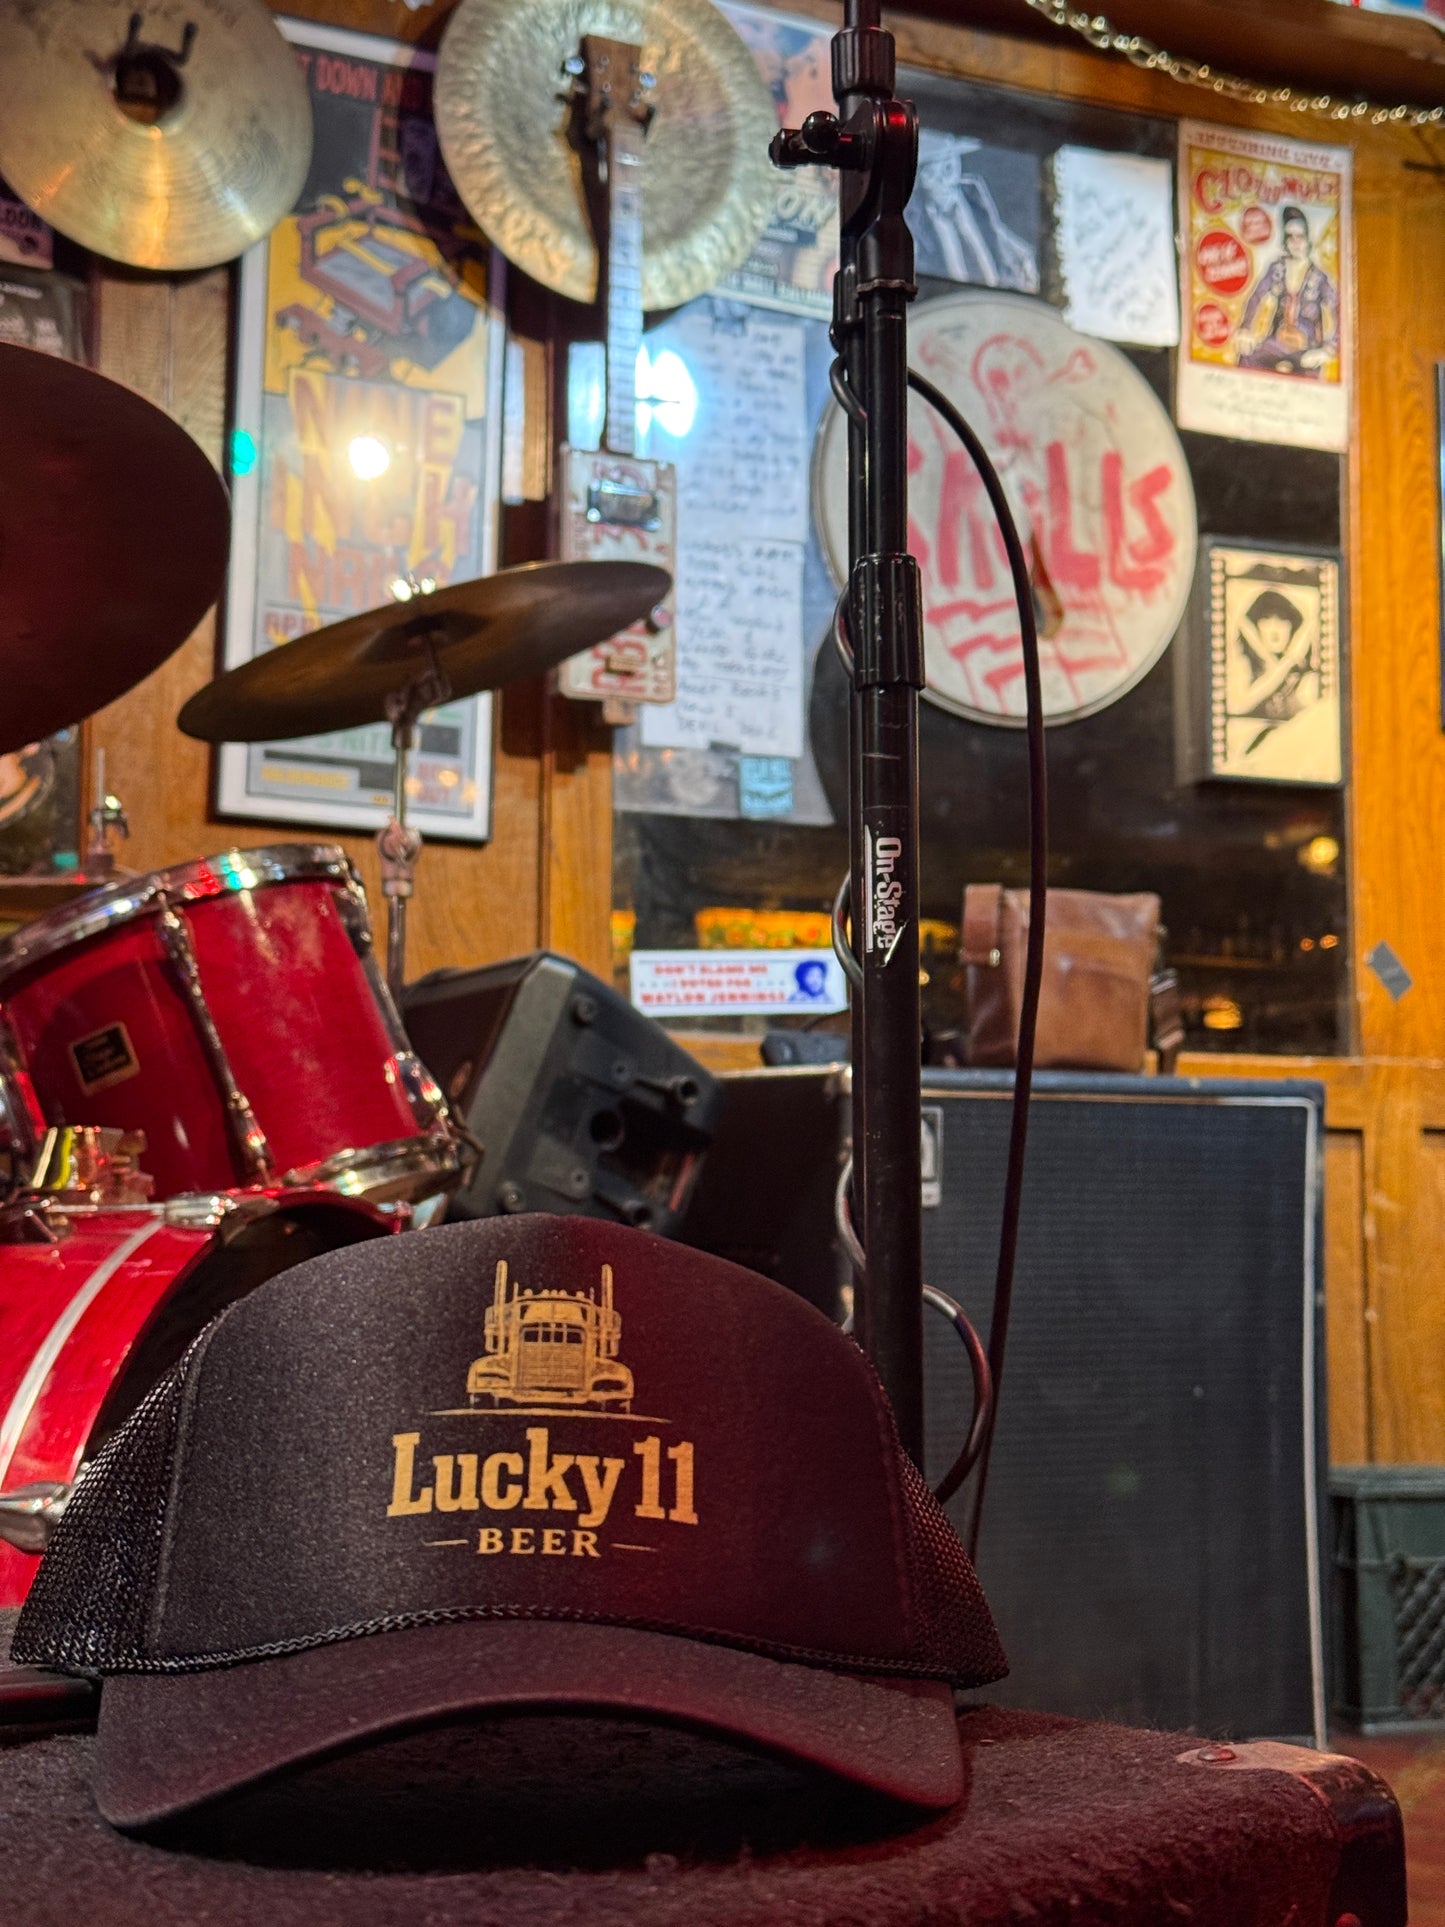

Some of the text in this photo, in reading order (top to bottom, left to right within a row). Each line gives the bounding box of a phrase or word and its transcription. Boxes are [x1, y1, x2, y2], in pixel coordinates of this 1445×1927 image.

[873, 837, 902, 948] On-Stage
[700, 964, 745, 975] BLAME
[749, 964, 768, 975] ME
[641, 992, 705, 1005] WAYLON
[386, 1427, 699, 1528] Lucky 11
[477, 1527, 601, 1558] BEER
